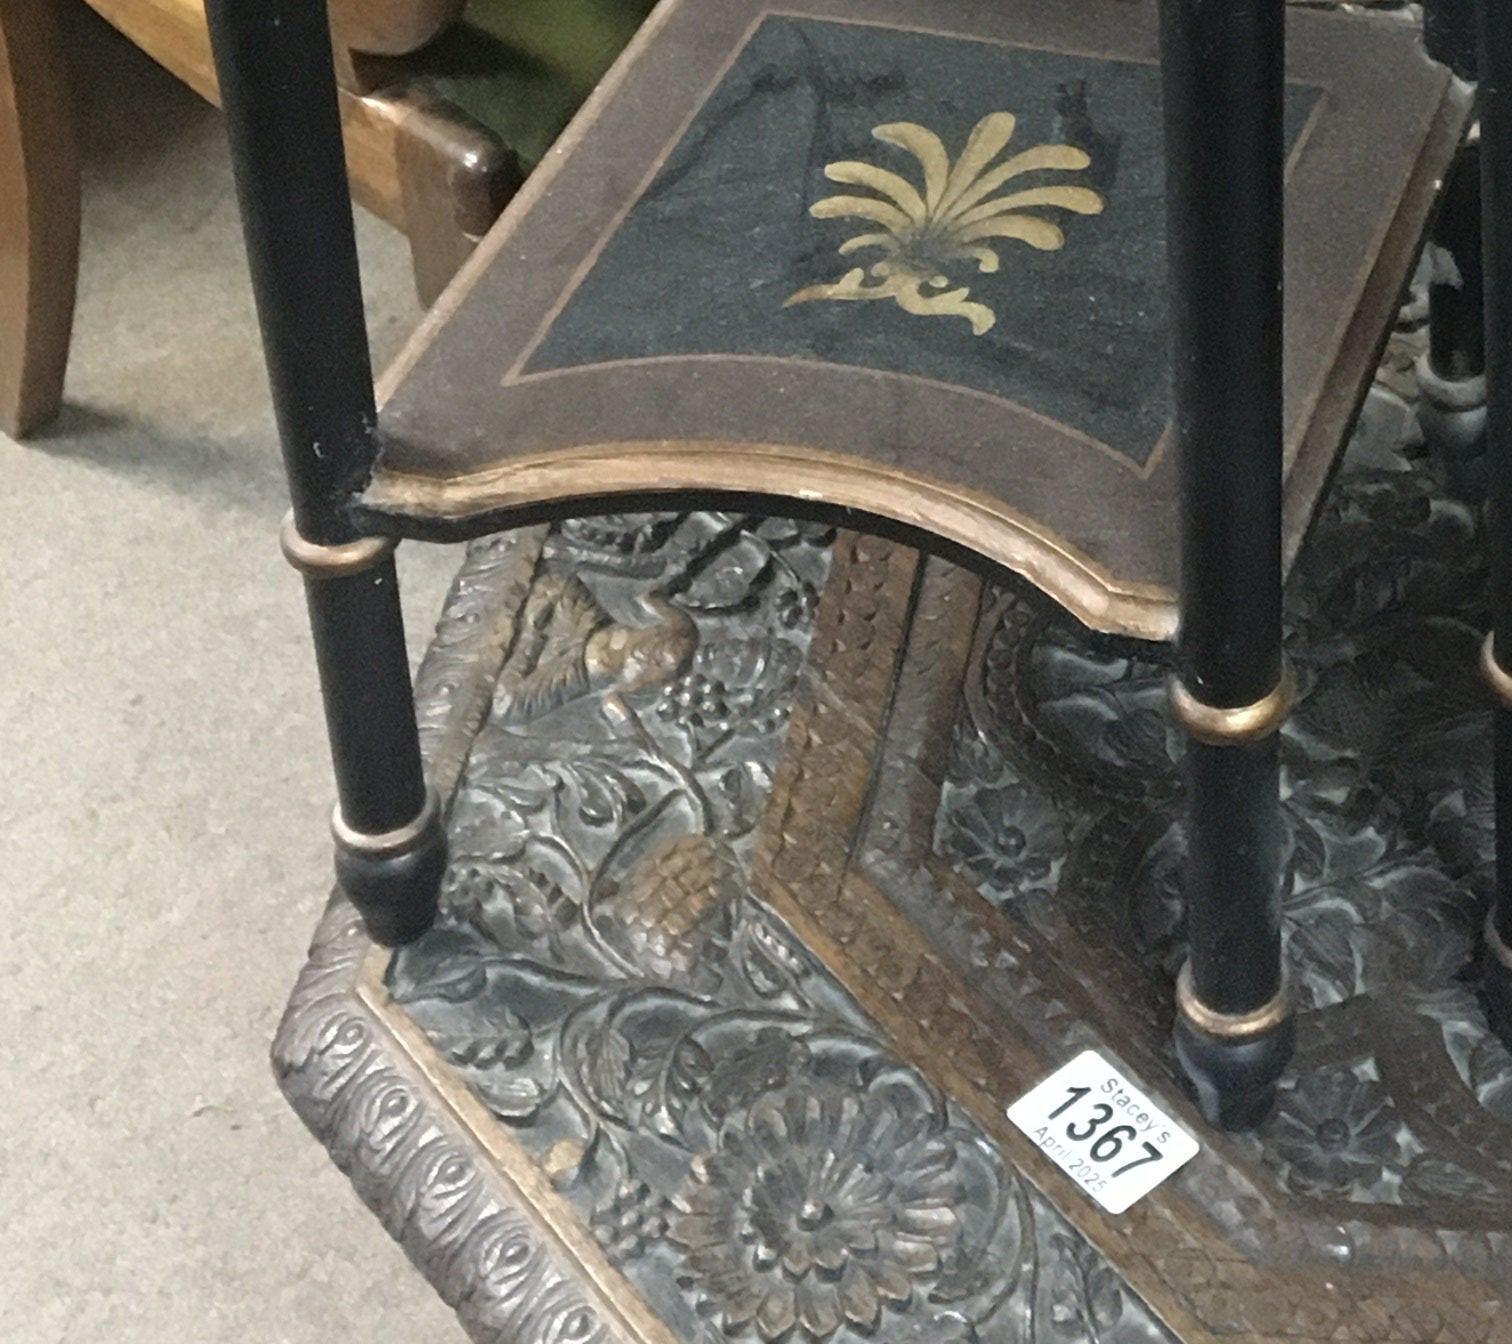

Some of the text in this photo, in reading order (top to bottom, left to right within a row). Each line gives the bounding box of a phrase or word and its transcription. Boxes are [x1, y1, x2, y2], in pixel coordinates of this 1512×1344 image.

[1048, 1086, 1163, 1178] 1367
[1101, 1078, 1171, 1144] Stacey's
[1034, 1126, 1108, 1193] April 2025
